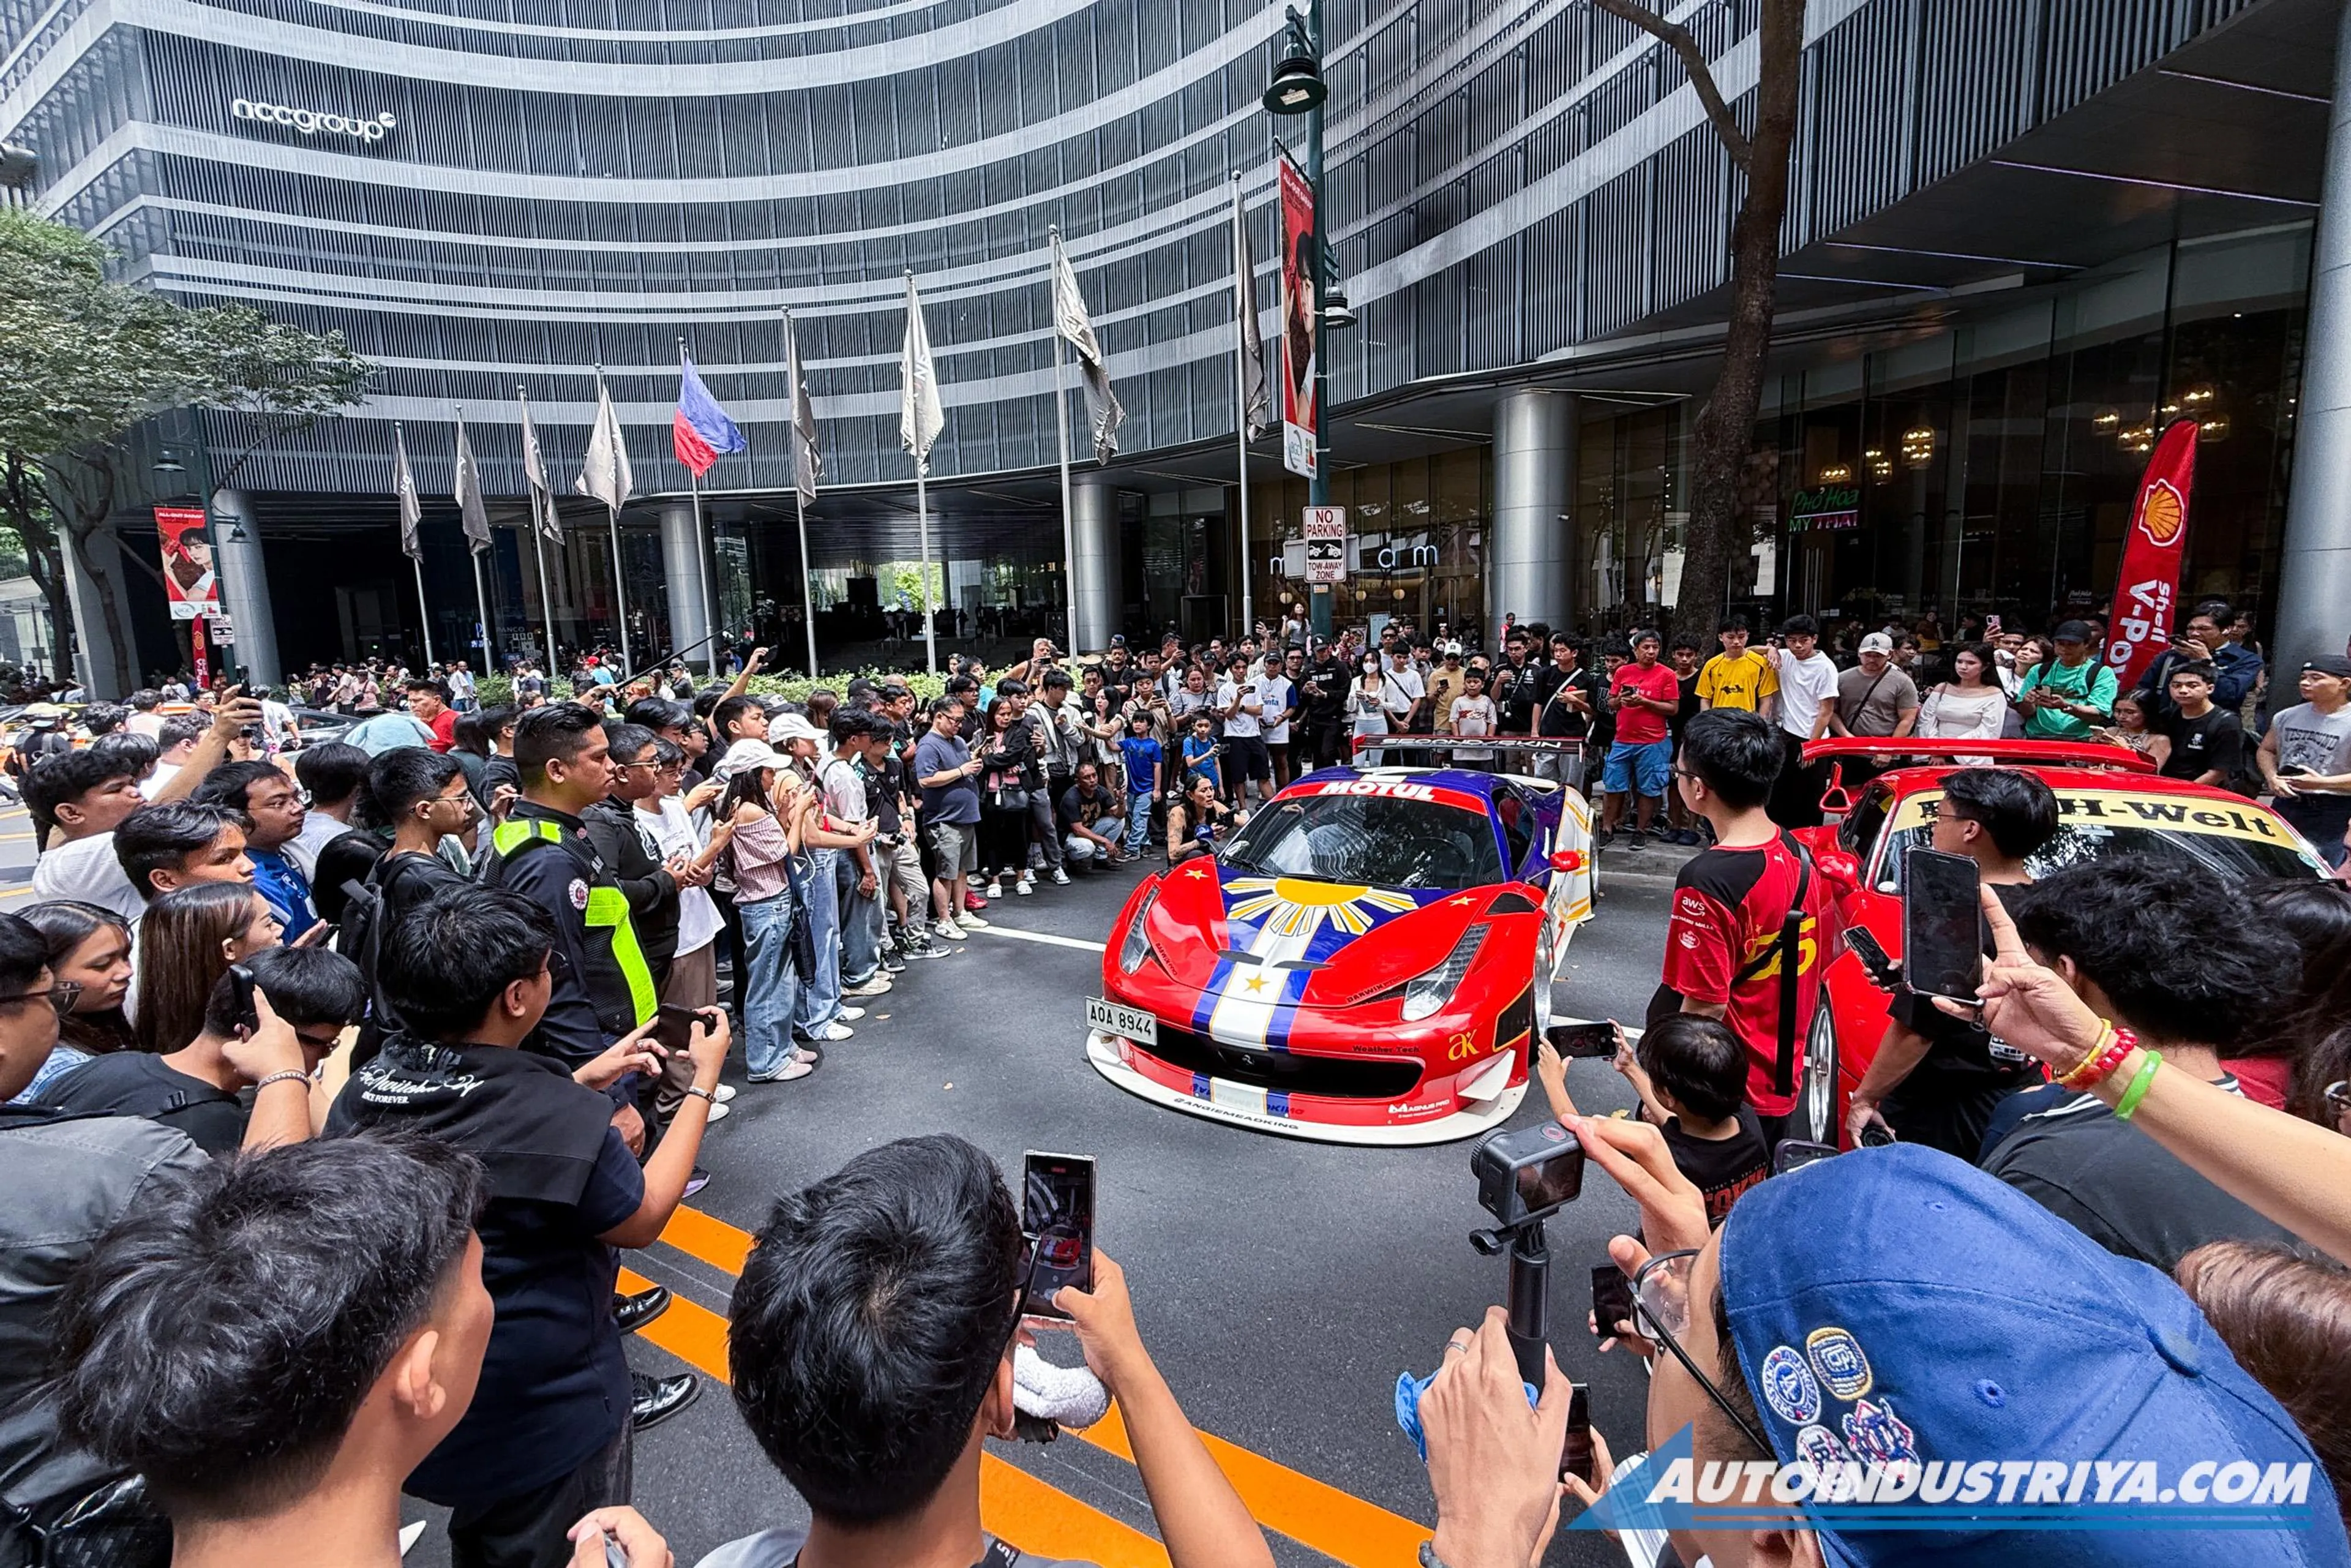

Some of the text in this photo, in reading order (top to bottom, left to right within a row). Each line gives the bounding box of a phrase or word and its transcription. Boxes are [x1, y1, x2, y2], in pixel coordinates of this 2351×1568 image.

[232, 98, 384, 143] nccgroup
[1316, 510, 1333, 523] NO
[1307, 524, 1343, 537] PARKING
[1308, 561, 1342, 570] TOW-AWAY
[2150, 580, 2170, 643] Shell
[2110, 579, 2158, 680] V-Po
[1318, 782, 1435, 801] MOTUL
[1682, 896, 1705, 910] aws
[1119, 1012, 1151, 1036] 8944
